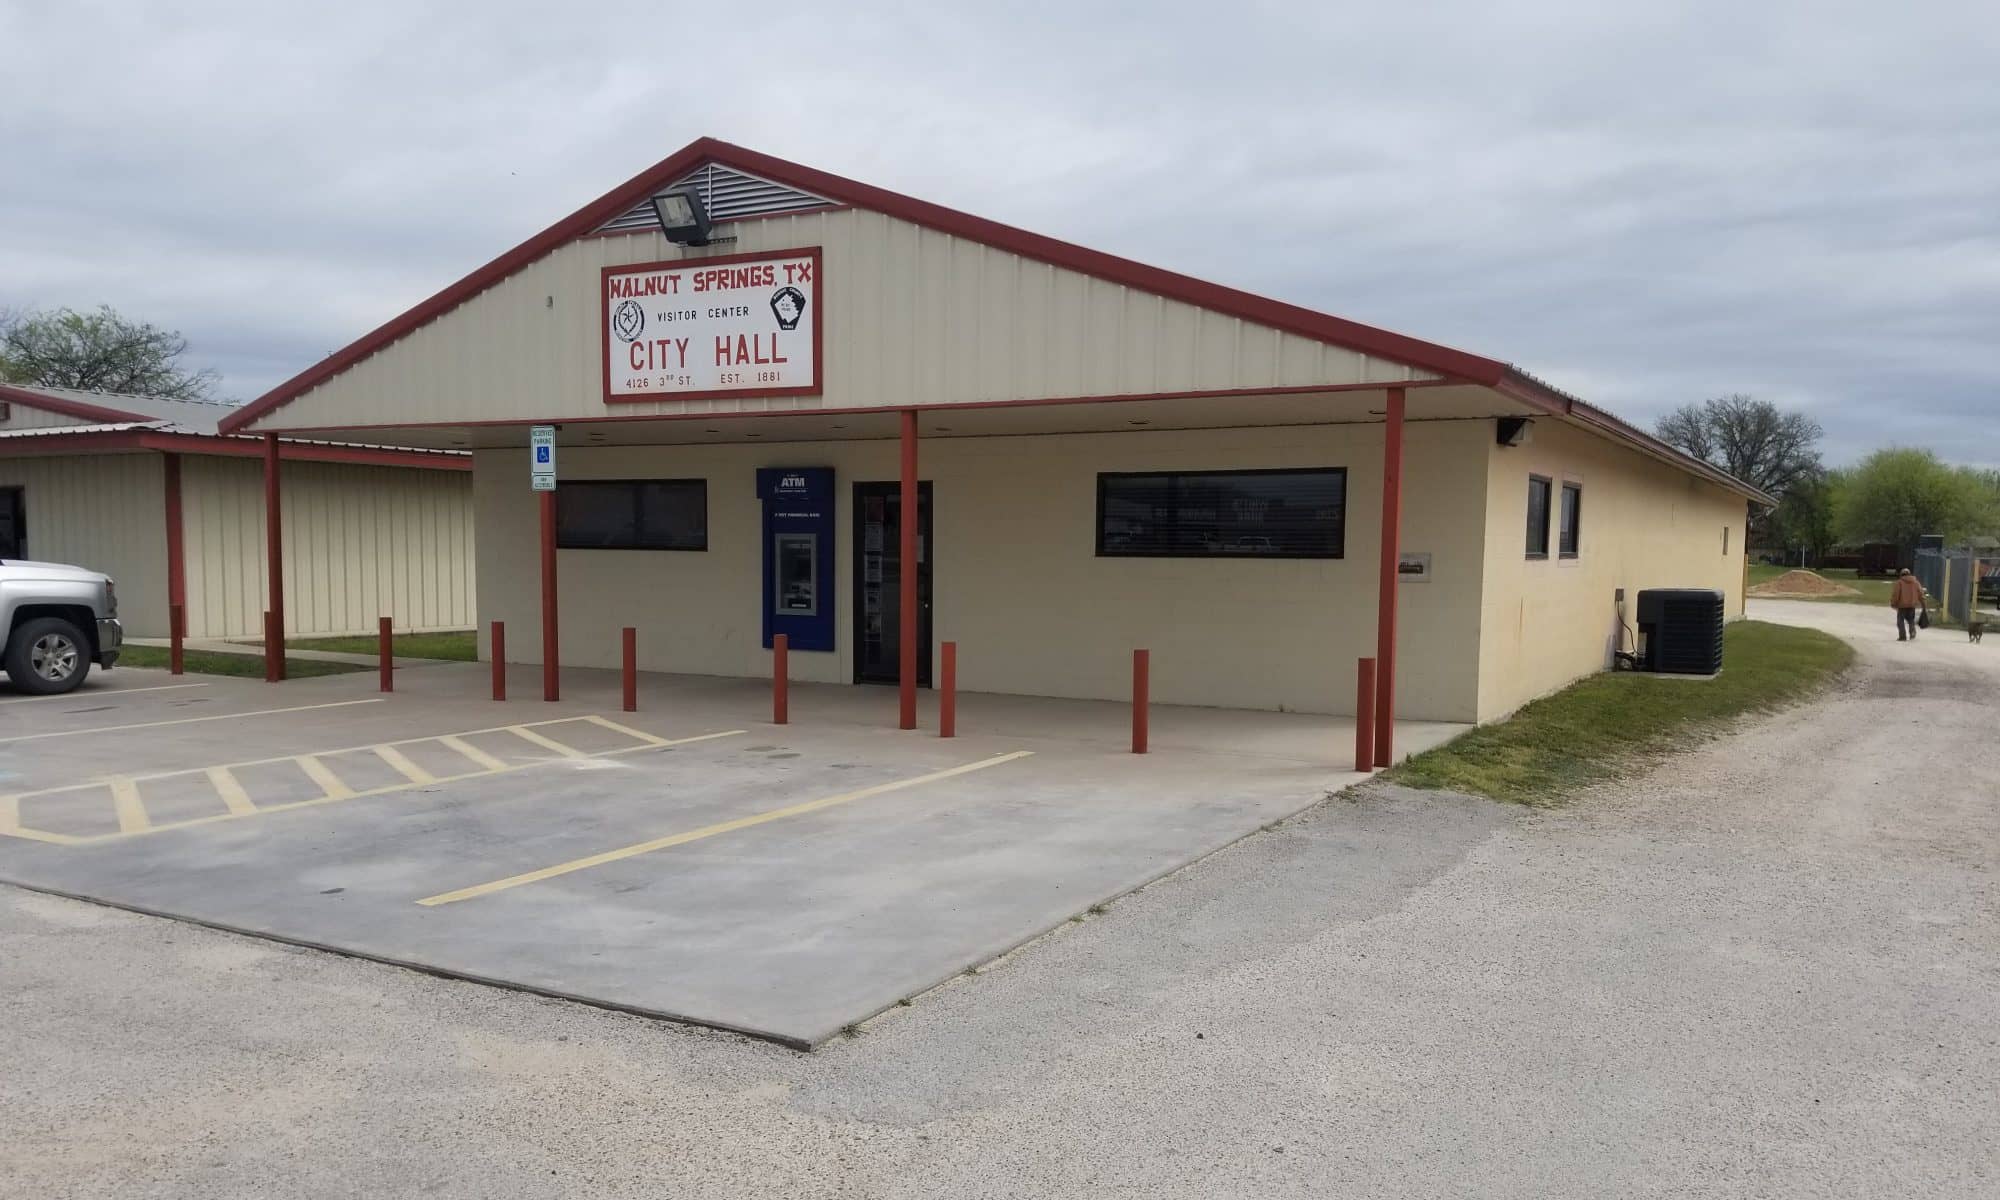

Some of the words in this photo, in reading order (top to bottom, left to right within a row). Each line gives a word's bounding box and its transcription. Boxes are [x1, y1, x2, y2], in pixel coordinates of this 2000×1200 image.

[610, 275, 681, 299] WALNUT
[694, 265, 777, 292] SPRINGS,
[783, 262, 812, 283] TX
[658, 311, 697, 322] VISITOR
[708, 306, 749, 318] CENTER
[630, 338, 689, 370] CITY
[715, 333, 787, 366] HALL
[626, 378, 649, 389] 4126
[721, 374, 745, 384] EST.
[758, 371, 780, 382] 1881
[781, 477, 805, 488] ATM
